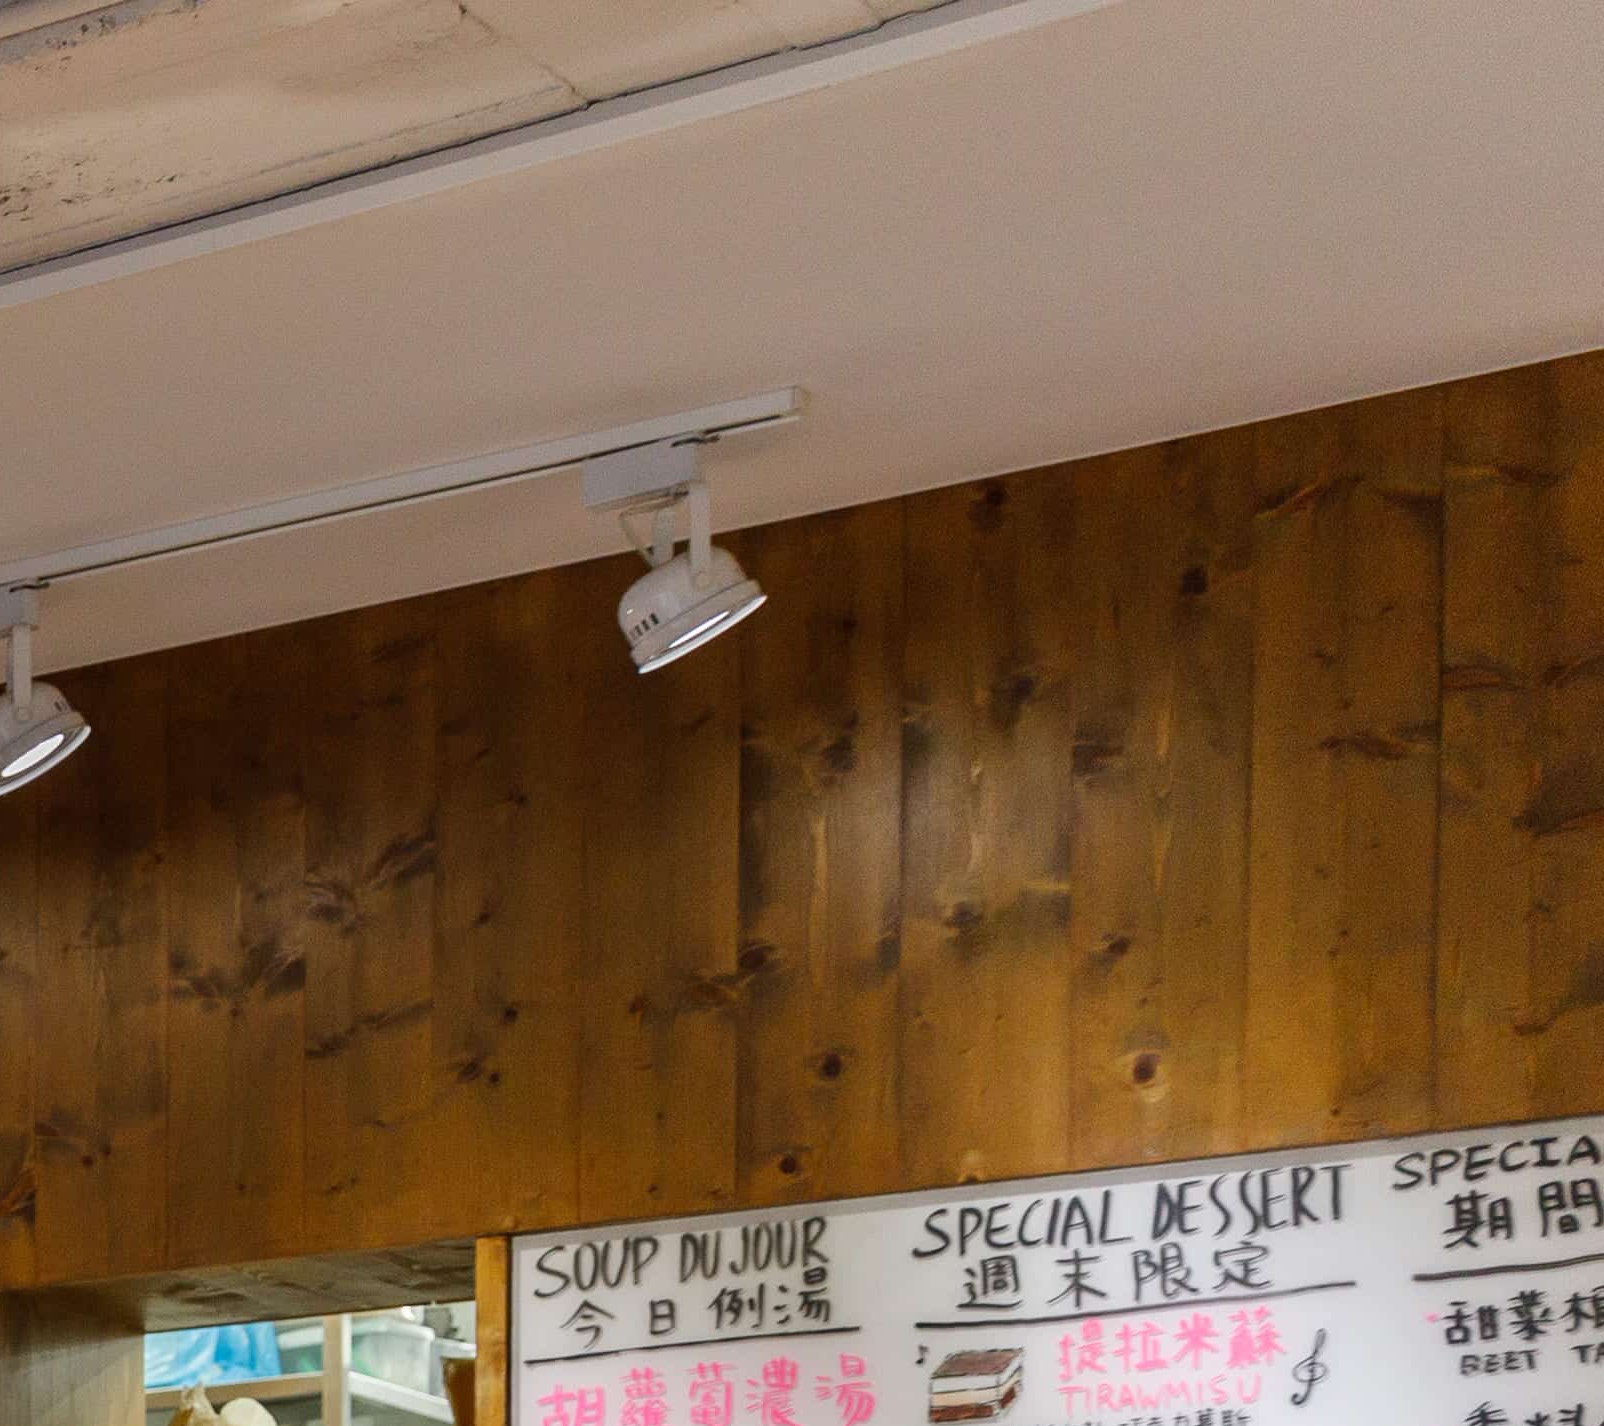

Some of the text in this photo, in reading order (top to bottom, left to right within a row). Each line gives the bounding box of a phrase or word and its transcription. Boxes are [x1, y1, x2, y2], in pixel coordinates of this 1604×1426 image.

[912, 1164, 1352, 1258] SPECIAL DESSERT
[534, 1217, 829, 1298] SOUP DU JOUR
[957, 1240, 1272, 1310] 週末限定
[561, 1267, 832, 1349] 今日例湯
[1058, 1305, 1288, 1381] 提拉米蘇
[1460, 1349, 1539, 1377] BEET
